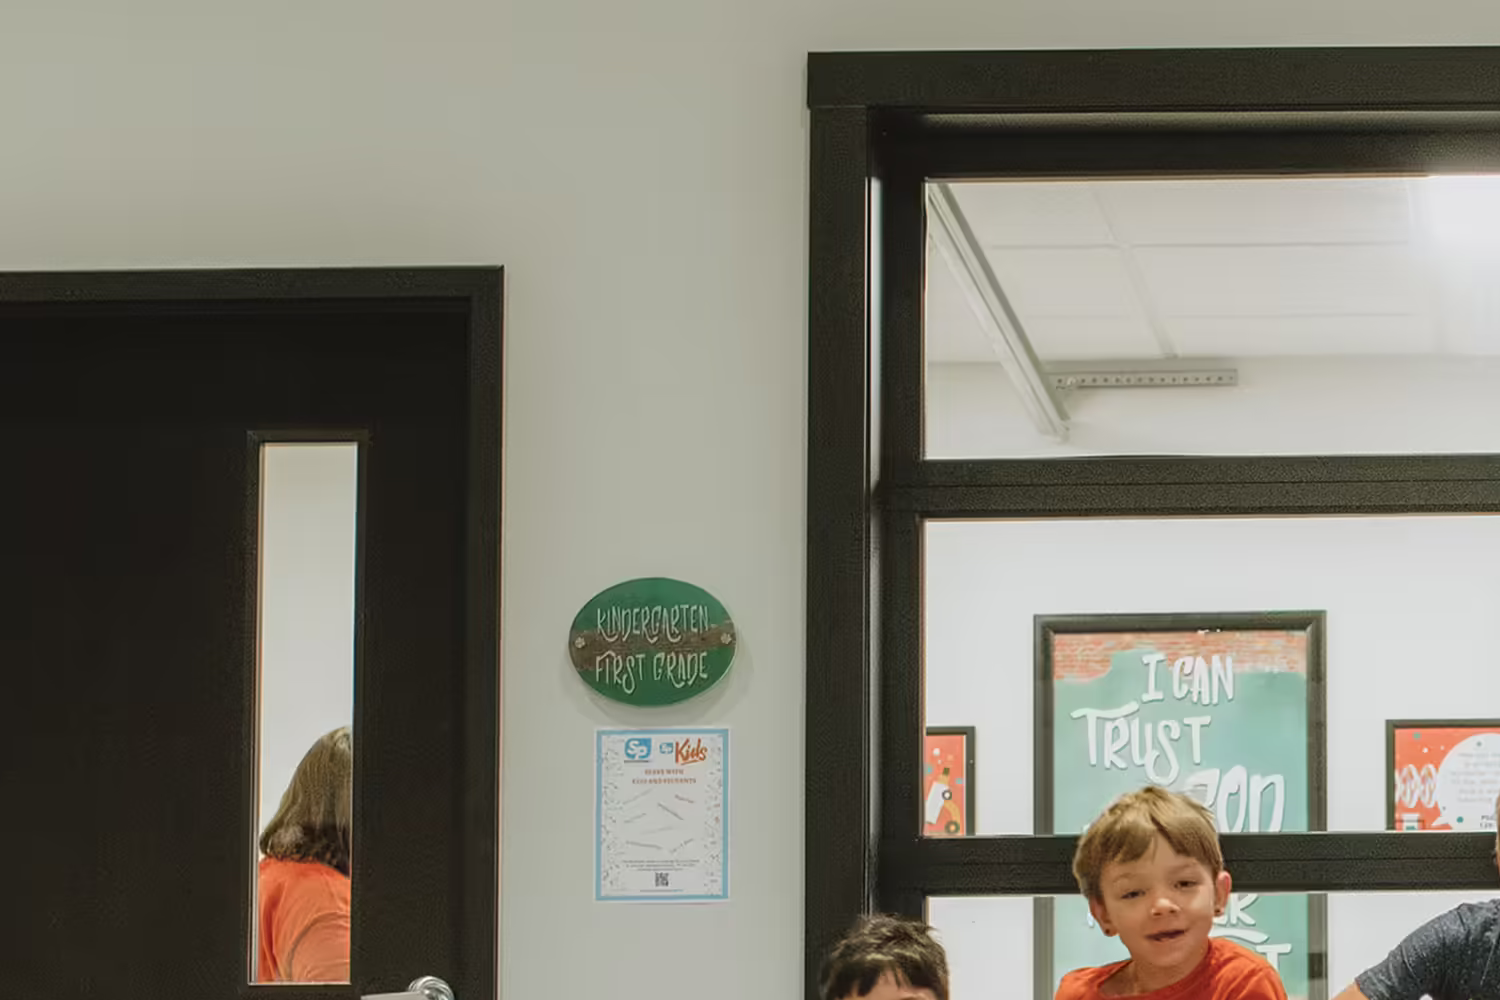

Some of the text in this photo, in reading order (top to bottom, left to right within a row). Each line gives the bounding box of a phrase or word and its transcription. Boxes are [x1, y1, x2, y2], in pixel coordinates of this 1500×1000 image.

[597, 604, 709, 644] KINDERGARTEN
[595, 650, 708, 694] FIRST GRADE
[1141, 652, 1235, 706] I CAN
[675, 738, 708, 764] Kids
[1069, 700, 1212, 787] TRUST
